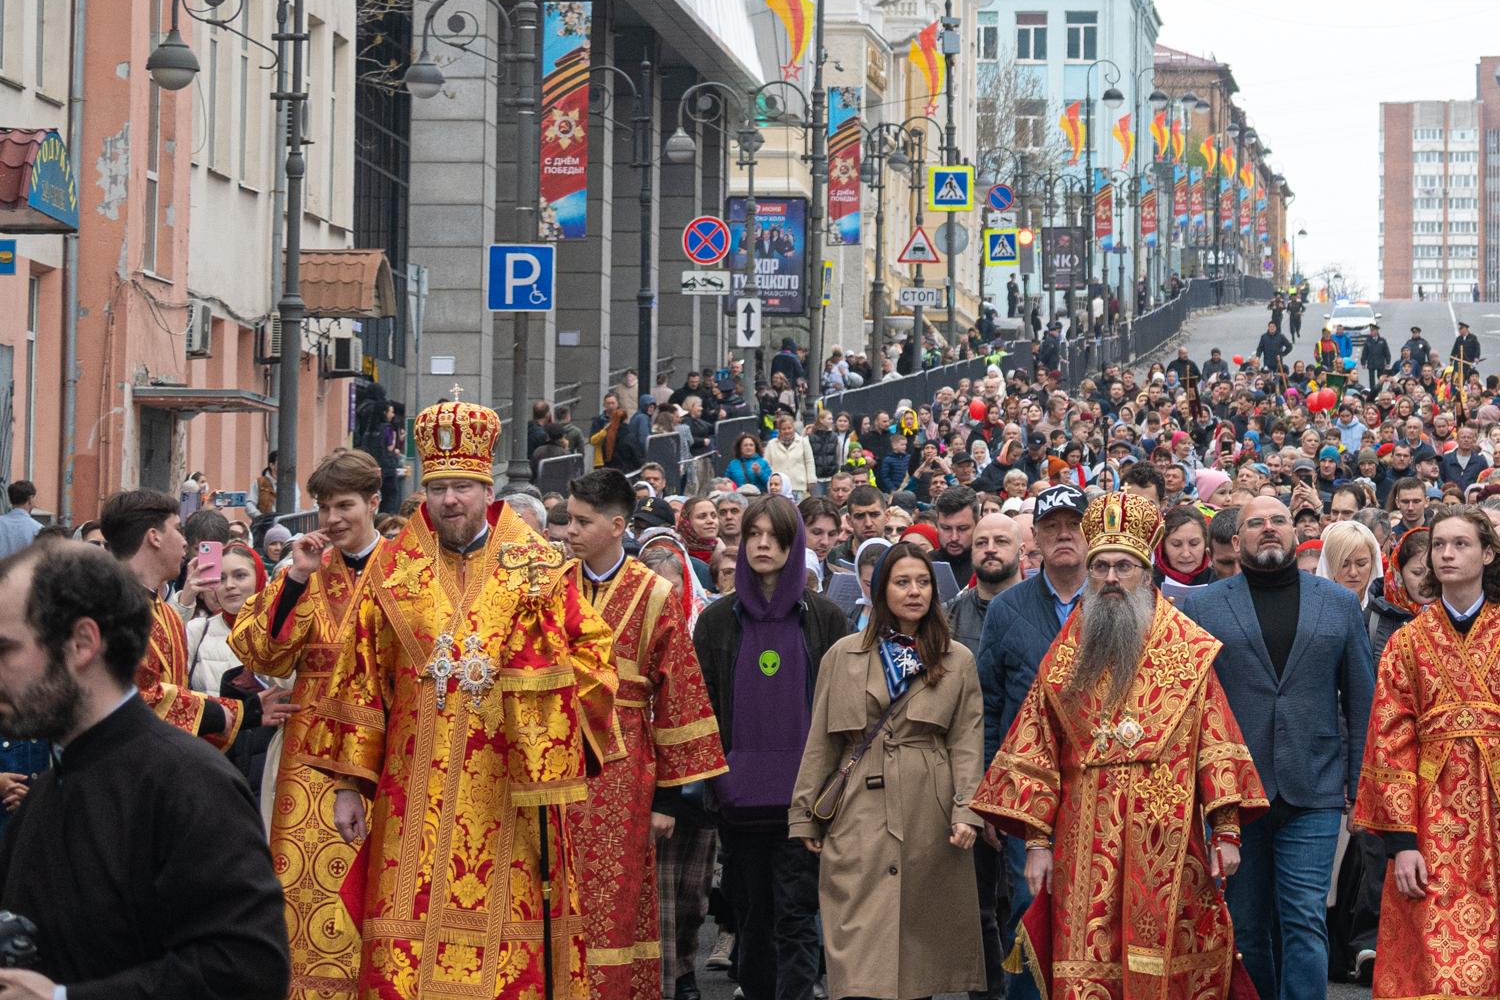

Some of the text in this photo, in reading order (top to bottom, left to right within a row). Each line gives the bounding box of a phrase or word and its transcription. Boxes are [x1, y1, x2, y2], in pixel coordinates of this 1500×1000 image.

[544, 156, 580, 166] С ДНЁМ
[544, 166, 585, 175] ПОБЕДЫ!
[754, 258, 780, 274] ХОР
[505, 253, 541, 304] P
[733, 273, 799, 290] ТУЕЦКОГО
[902, 290, 935, 302] СТОП
